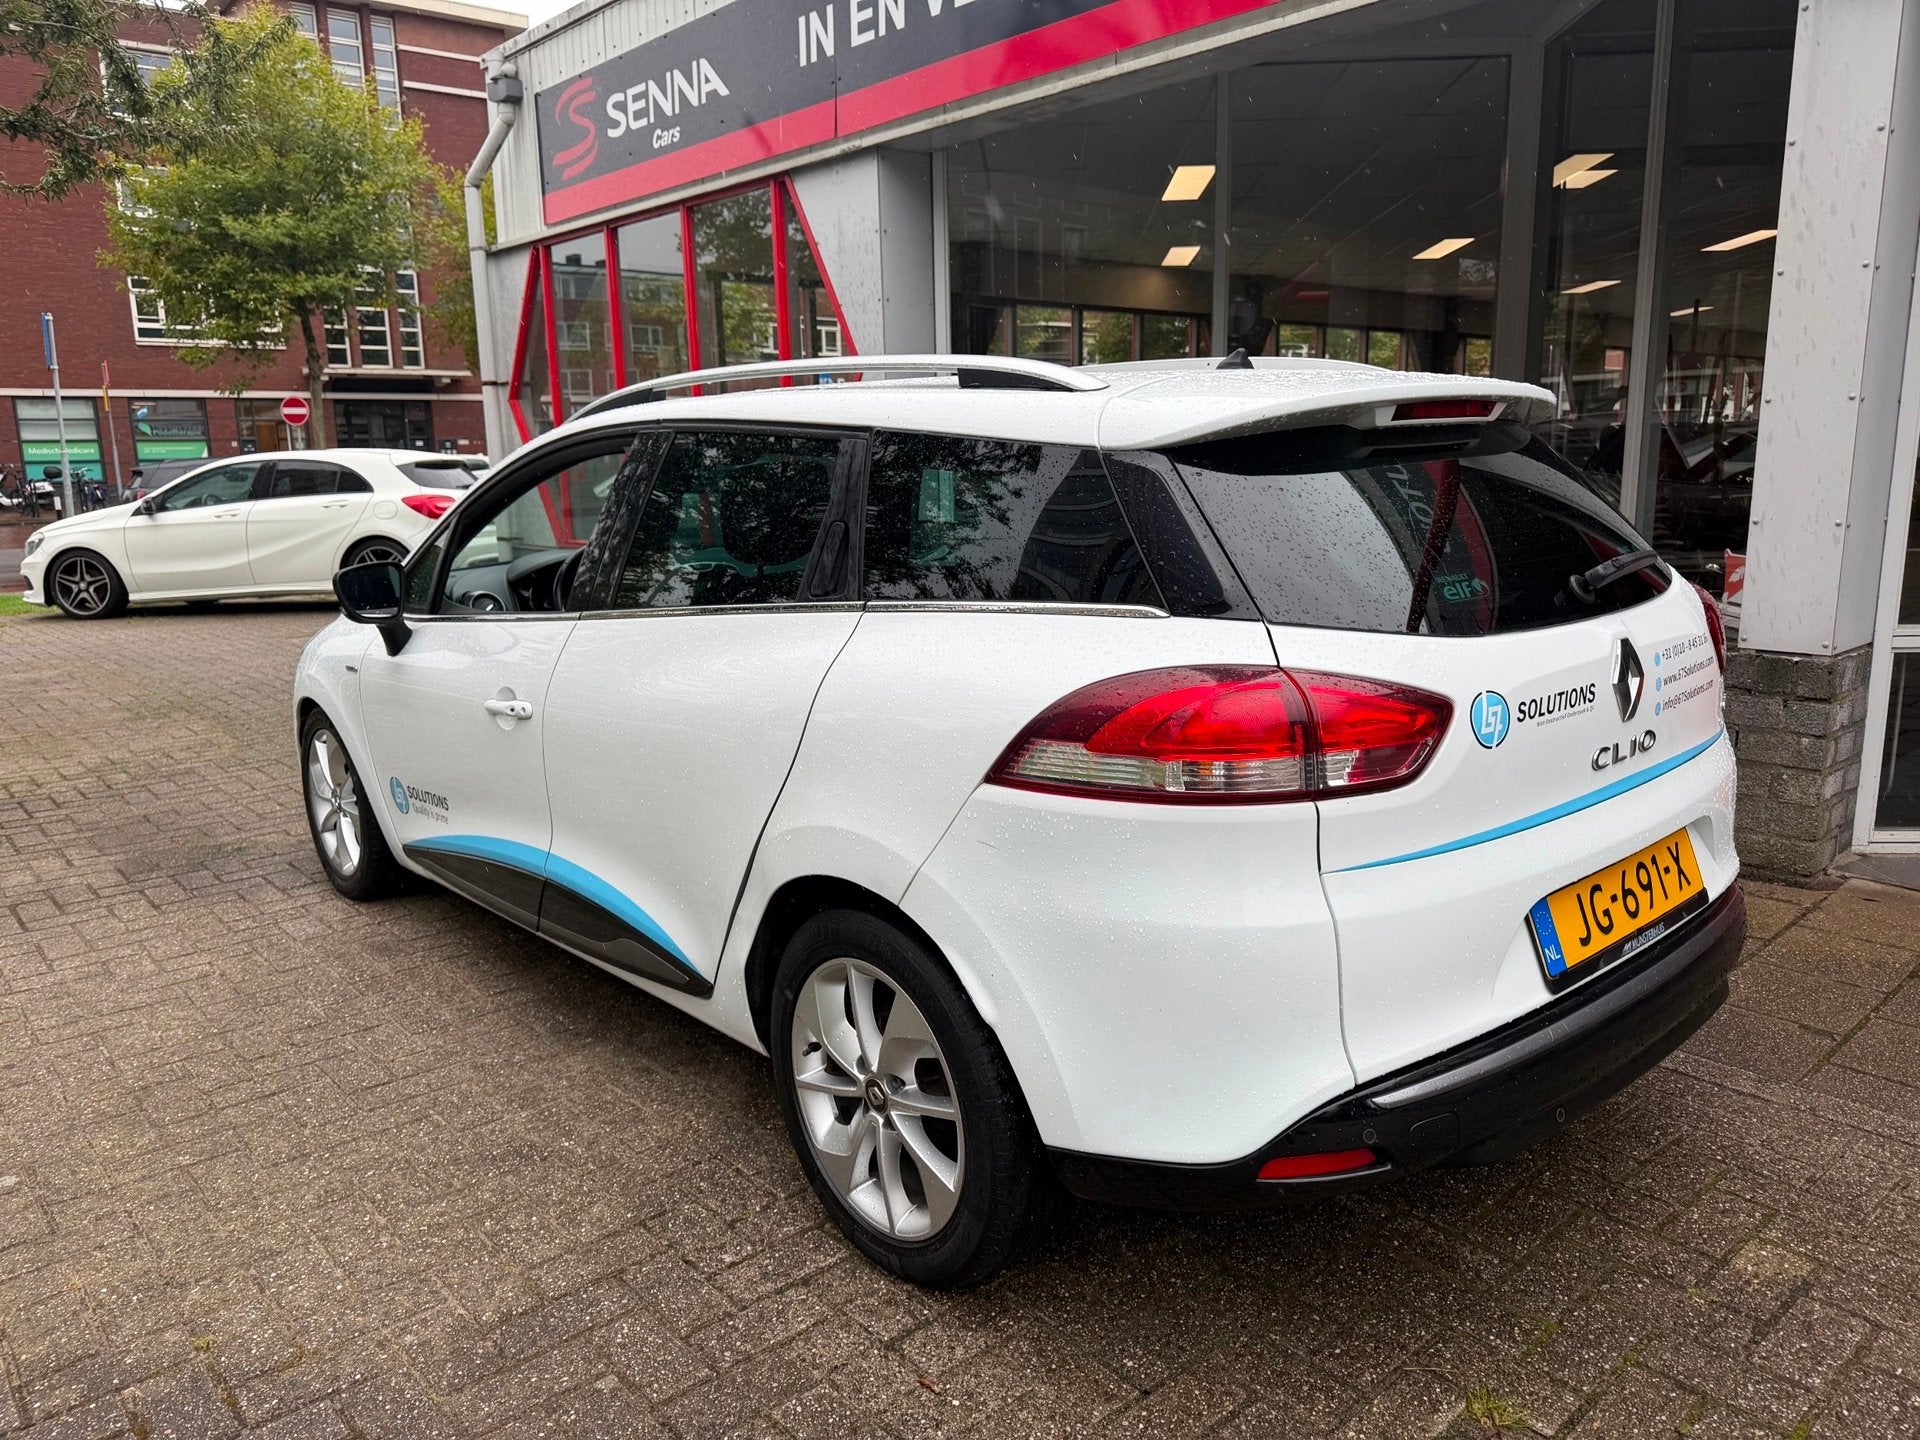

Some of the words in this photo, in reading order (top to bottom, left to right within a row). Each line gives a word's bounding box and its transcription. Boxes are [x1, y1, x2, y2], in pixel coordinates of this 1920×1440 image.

[798, 3, 835, 67] IN
[849, 0, 906, 48] EN
[606, 58, 730, 138] SENNA
[652, 126, 681, 149] Cars
[28, 447, 61, 455] Medisch
[63, 446, 95, 455] edicure
[1443, 581, 1472, 600] elf
[1663, 656, 1714, 687] www.67Solutions.com
[1517, 683, 1596, 723] SOLUTIONS
[1662, 680, 1713, 711] info@67Solutions.com
[1592, 729, 1656, 772] CLIO
[407, 785, 449, 811] SOLUTIONS
[1576, 841, 1692, 947] JG-691-X
[1544, 944, 1562, 963] NL
